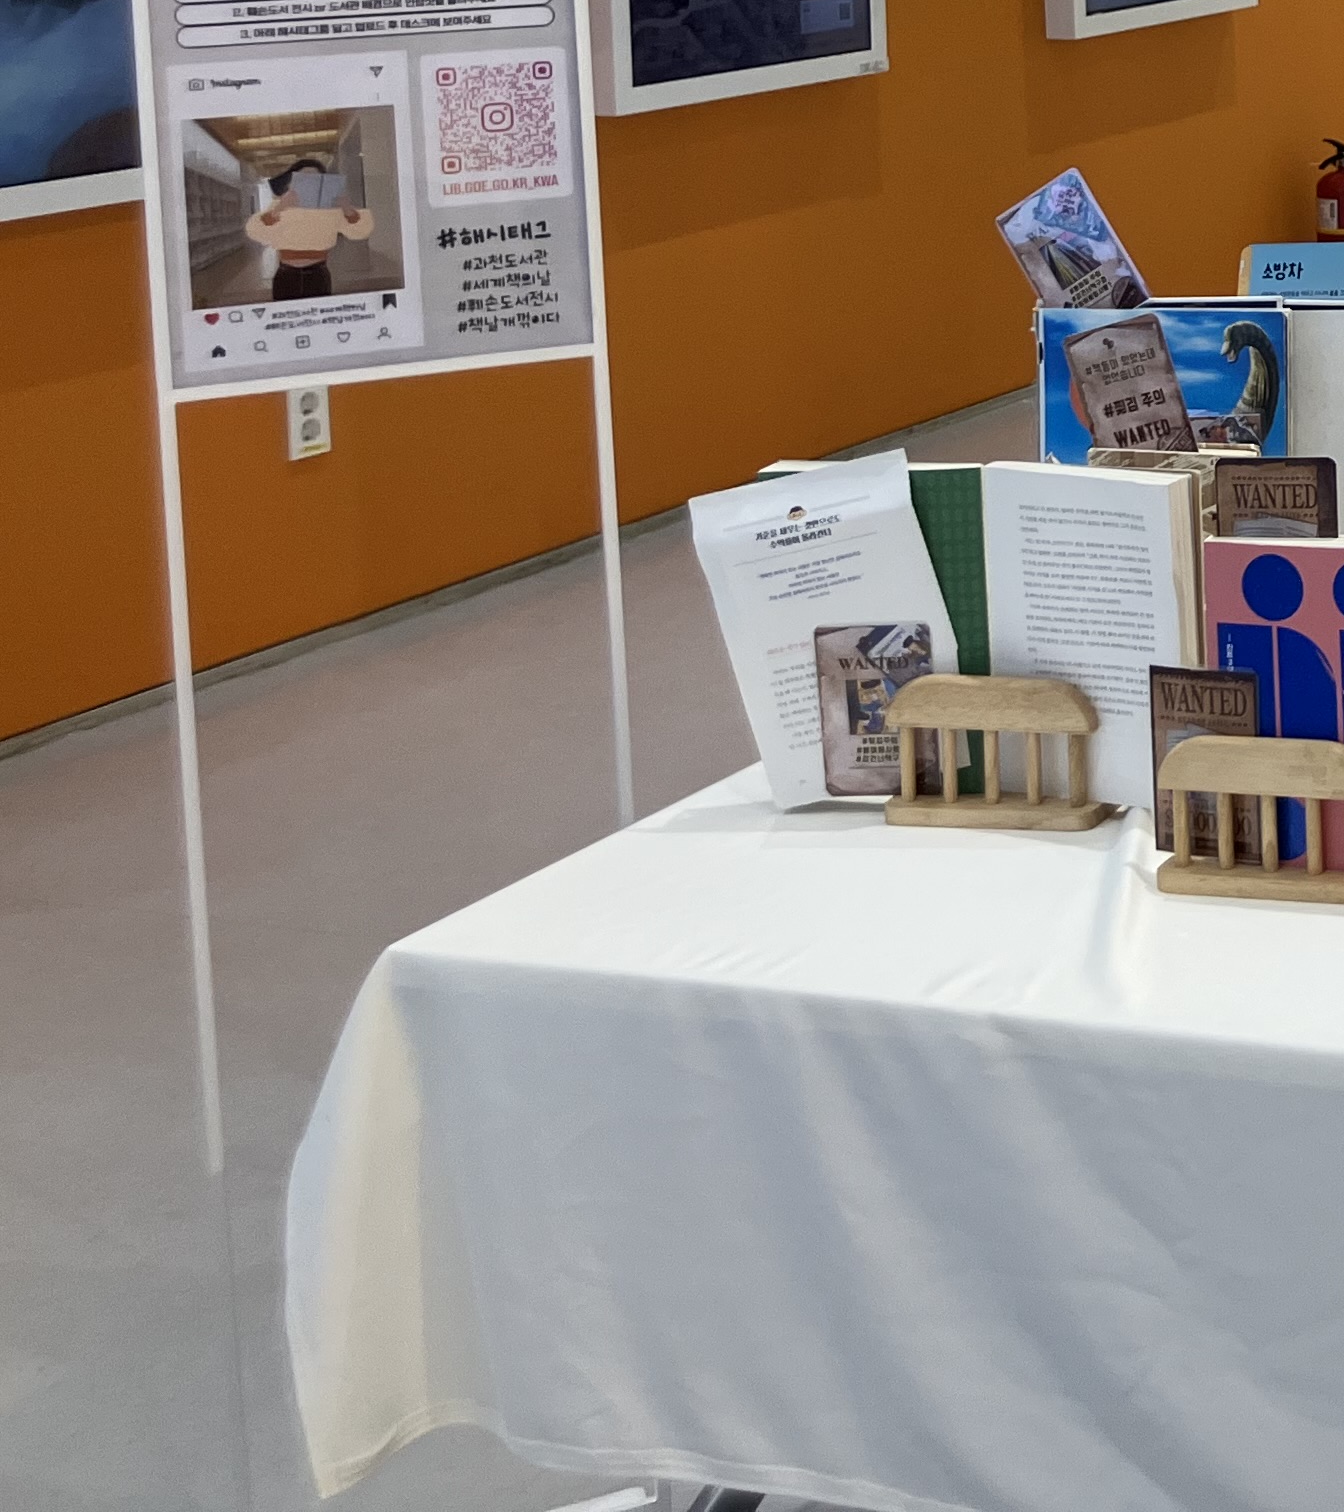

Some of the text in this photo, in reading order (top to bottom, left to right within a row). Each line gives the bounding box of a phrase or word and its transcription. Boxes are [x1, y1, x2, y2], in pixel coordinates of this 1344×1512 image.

[437, 221, 551, 249] #해시태그
[463, 249, 548, 271] #과천도서관
[1262, 261, 1304, 281] 소방차
[1141, 388, 1166, 407] 주의
[1114, 419, 1171, 448] WANTED
[1233, 484, 1318, 509] WANTED
[839, 656, 909, 671] WANTED
[1160, 681, 1247, 718] WANTED
